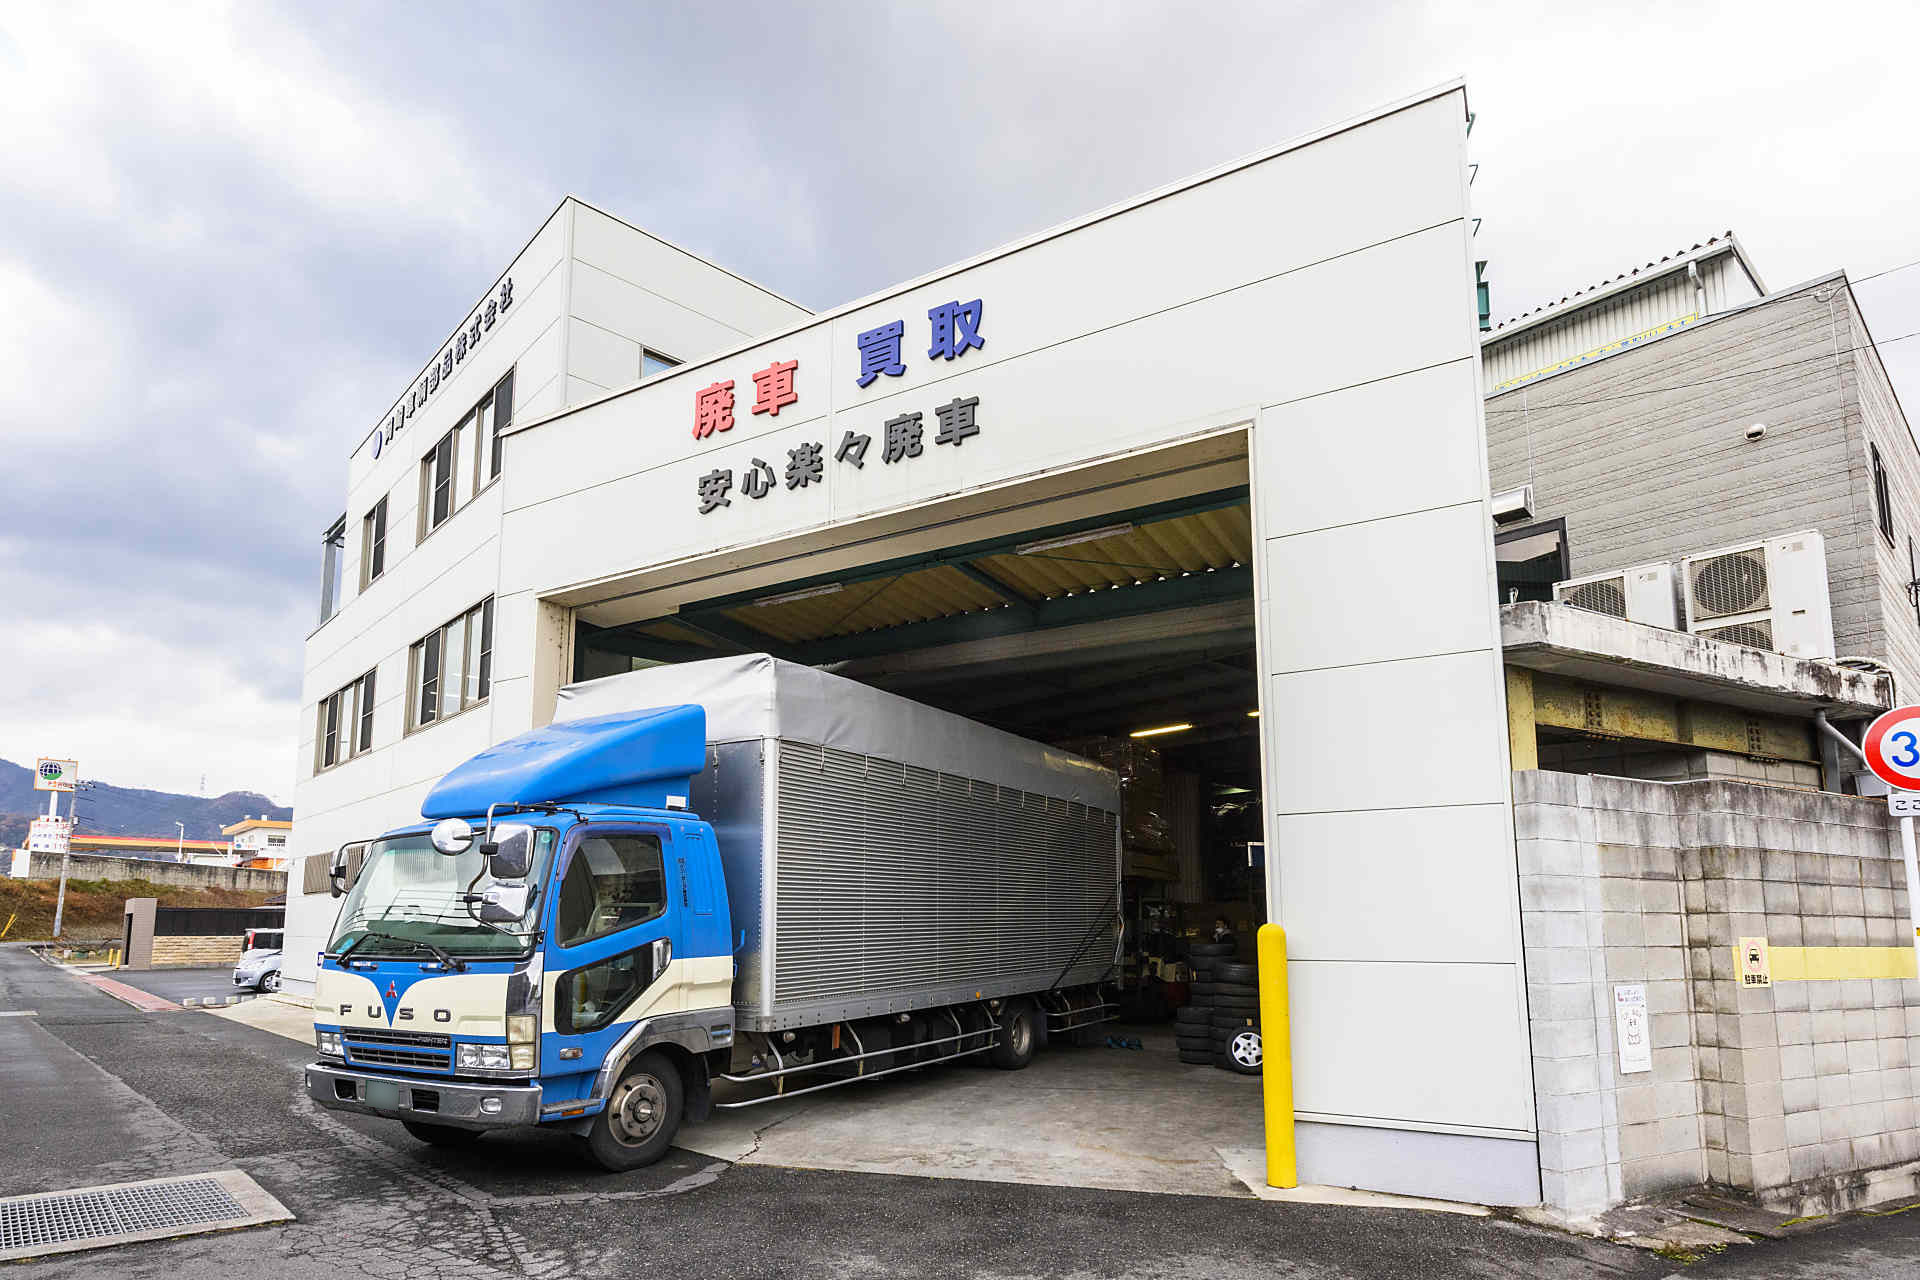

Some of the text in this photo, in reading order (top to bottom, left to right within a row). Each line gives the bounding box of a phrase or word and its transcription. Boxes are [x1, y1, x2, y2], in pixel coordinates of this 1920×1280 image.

[692, 299, 985, 440] 廃車 買取
[698, 396, 980, 514] 安心楽々廃車
[340, 1004, 451, 1022] FUSO
